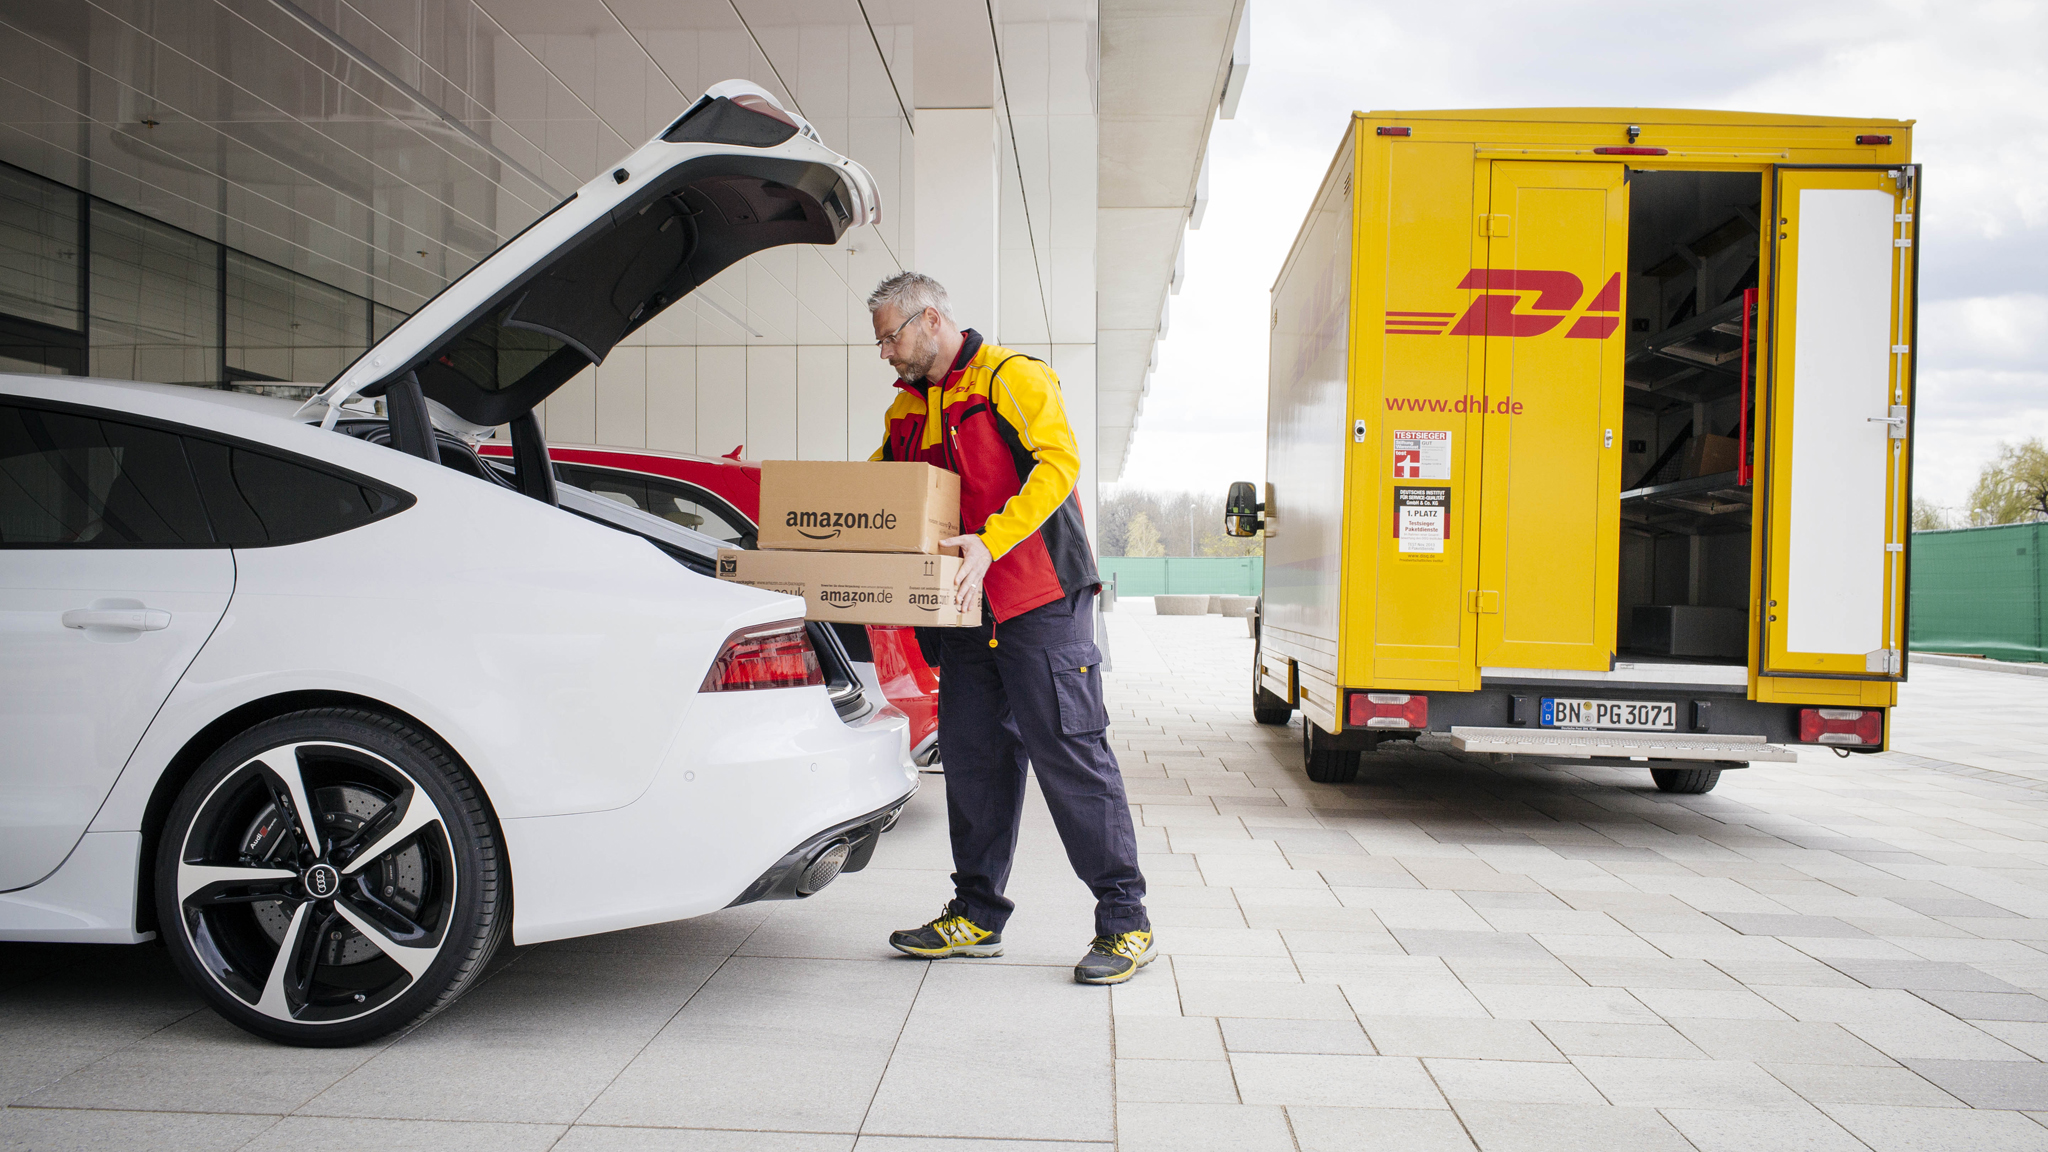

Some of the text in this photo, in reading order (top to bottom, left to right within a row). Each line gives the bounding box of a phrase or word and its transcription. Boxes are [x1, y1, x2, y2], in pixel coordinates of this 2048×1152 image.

[1385, 395, 1524, 415] www.dhl.de
[1396, 431, 1446, 440] TESTSIEGER
[786, 508, 897, 530] amazon.de
[820, 589, 893, 604] amazon.de
[1555, 702, 1581, 723] BN
[1596, 703, 1621, 725] PG
[1625, 704, 1674, 727] 3071
[249, 832, 263, 850] Audi
